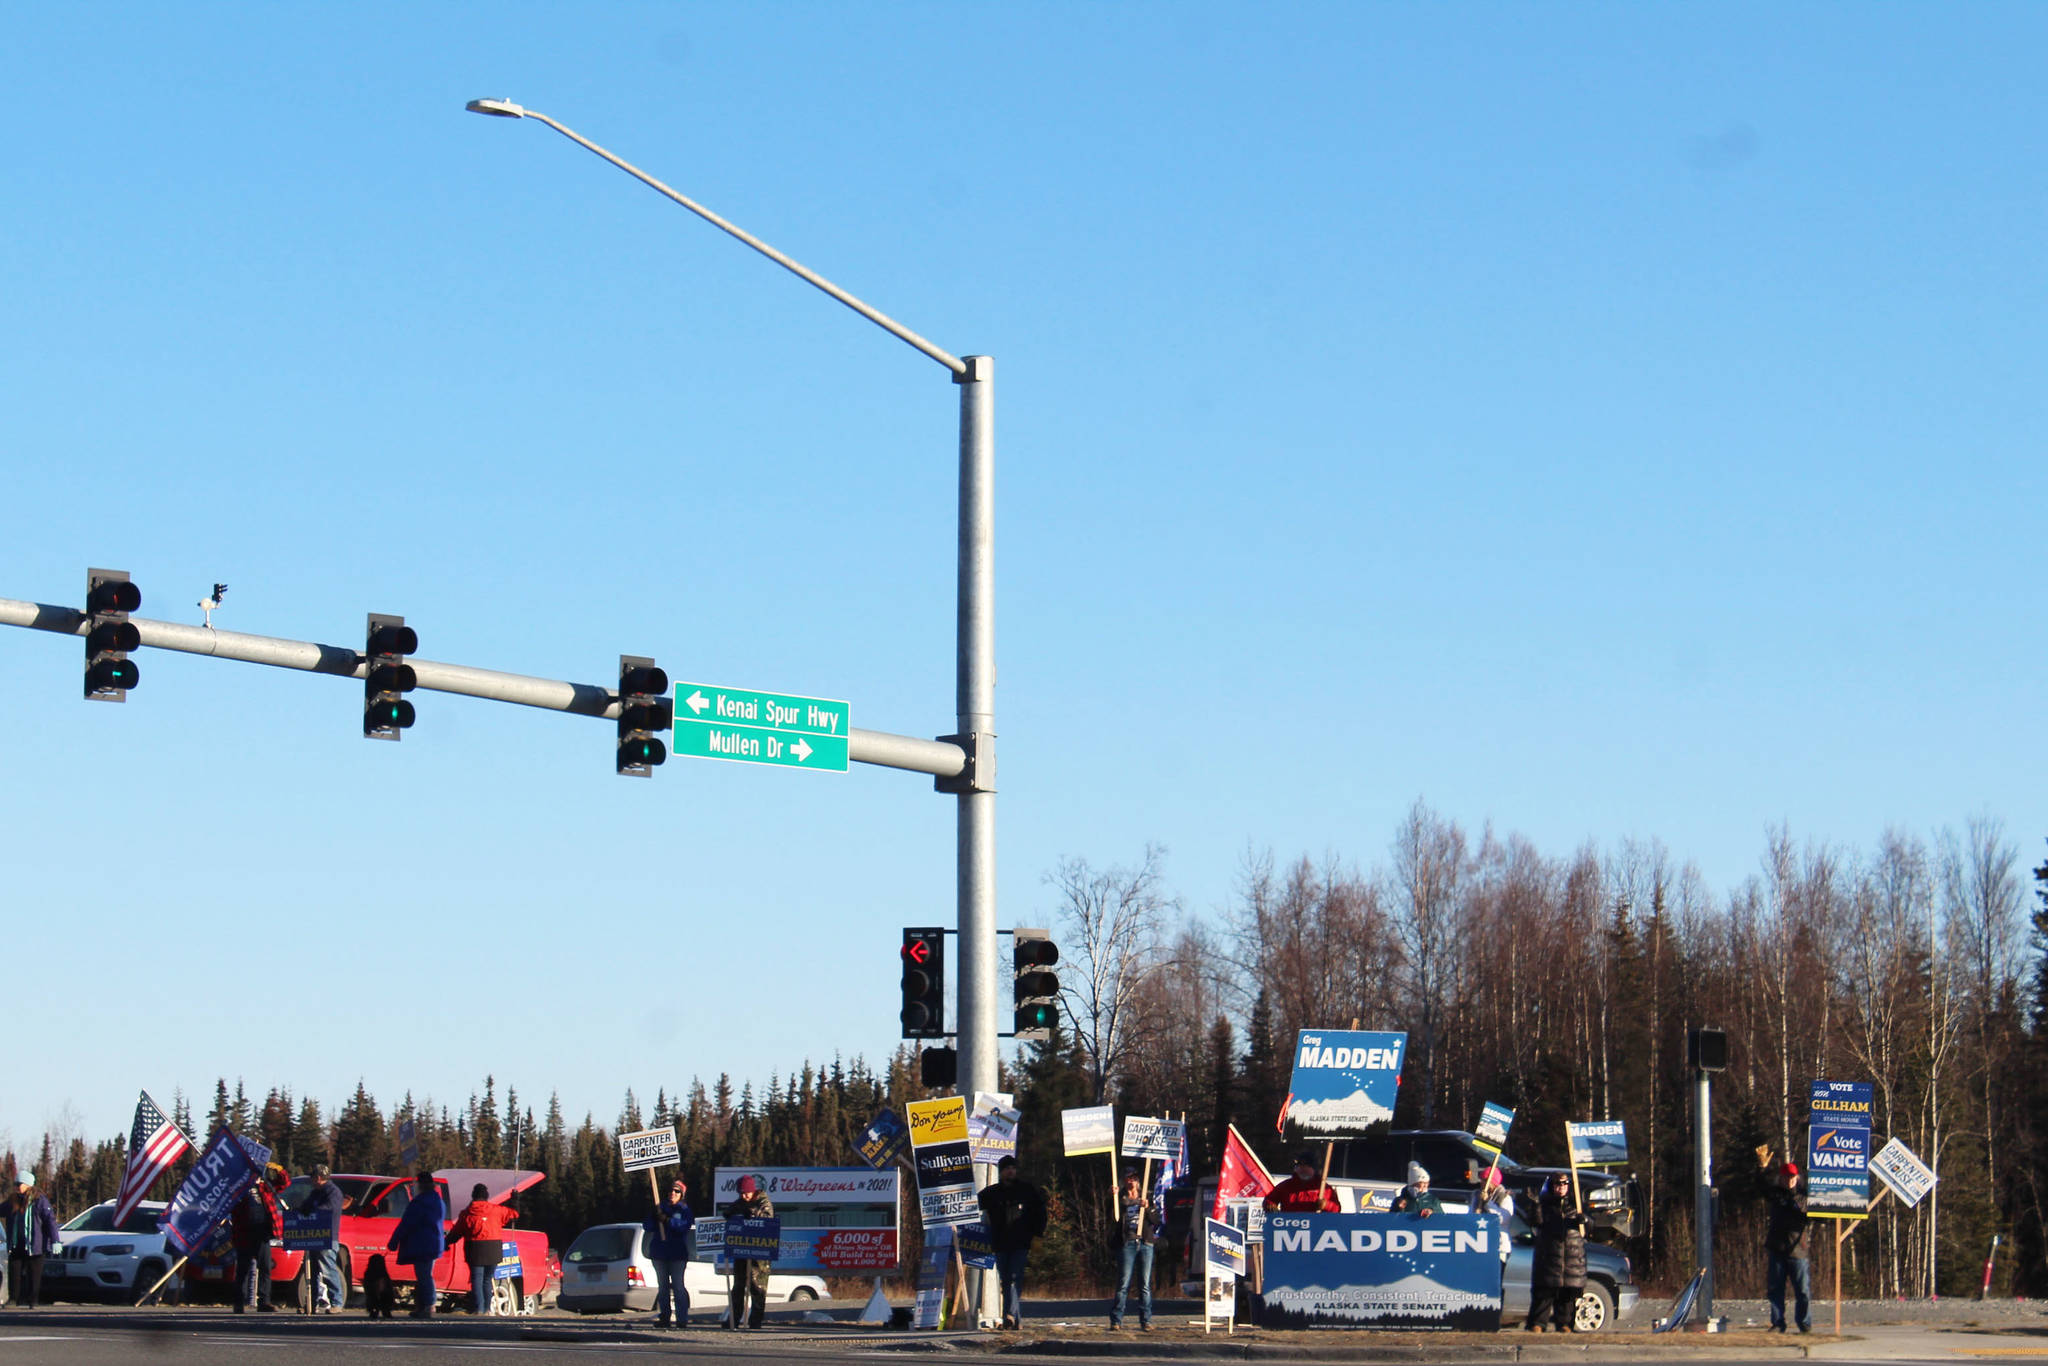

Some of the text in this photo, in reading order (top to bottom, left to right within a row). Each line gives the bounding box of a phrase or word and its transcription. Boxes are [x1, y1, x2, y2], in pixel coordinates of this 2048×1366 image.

[716, 694, 838, 734] Kenai Spur Hwy
[710, 730, 784, 758] Mullen Dr
[1302, 1034, 1322, 1046] Greg
[1298, 1046, 1400, 1070] MADDEN
[1829, 1083, 1854, 1092] VOTE
[1812, 1099, 1869, 1112] GILLHAM
[911, 1112, 931, 1128] Don
[931, 1104, 964, 1131] Young
[1128, 1123, 1178, 1136] CARPENTER
[1570, 1125, 1623, 1136] MADDEN
[623, 1133, 671, 1150] CARPENTER
[968, 1137, 1016, 1150] GILHAM
[1834, 1136, 1862, 1149] Vote
[920, 1154, 970, 1170] Sullivan
[1812, 1152, 1865, 1169] VANCE
[1886, 1145, 1929, 1186] CARPENTER
[780, 1178, 856, 1196] Walgreens
[867, 1178, 893, 1191] 2021!
[1810, 1176, 1861, 1186] MADDEN
[922, 1191, 972, 1206] CARPENTER
[698, 1222, 726, 1233] CARPE
[744, 1219, 764, 1227] VOTE
[1272, 1218, 1310, 1229] Greg
[284, 1229, 331, 1238] GILLHAM
[872, 1233, 885, 1245] sf
[727, 1235, 778, 1248] GILLHAM
[1210, 1232, 1242, 1254] Sullivan
[1273, 1230, 1488, 1253] MADDEN
[840, 1250, 864, 1258] Build
[1353, 1289, 1420, 1301] Consistent,
[1425, 1290, 1488, 1301] Tenacious
[1402, 1303, 1447, 1311] SENATE
